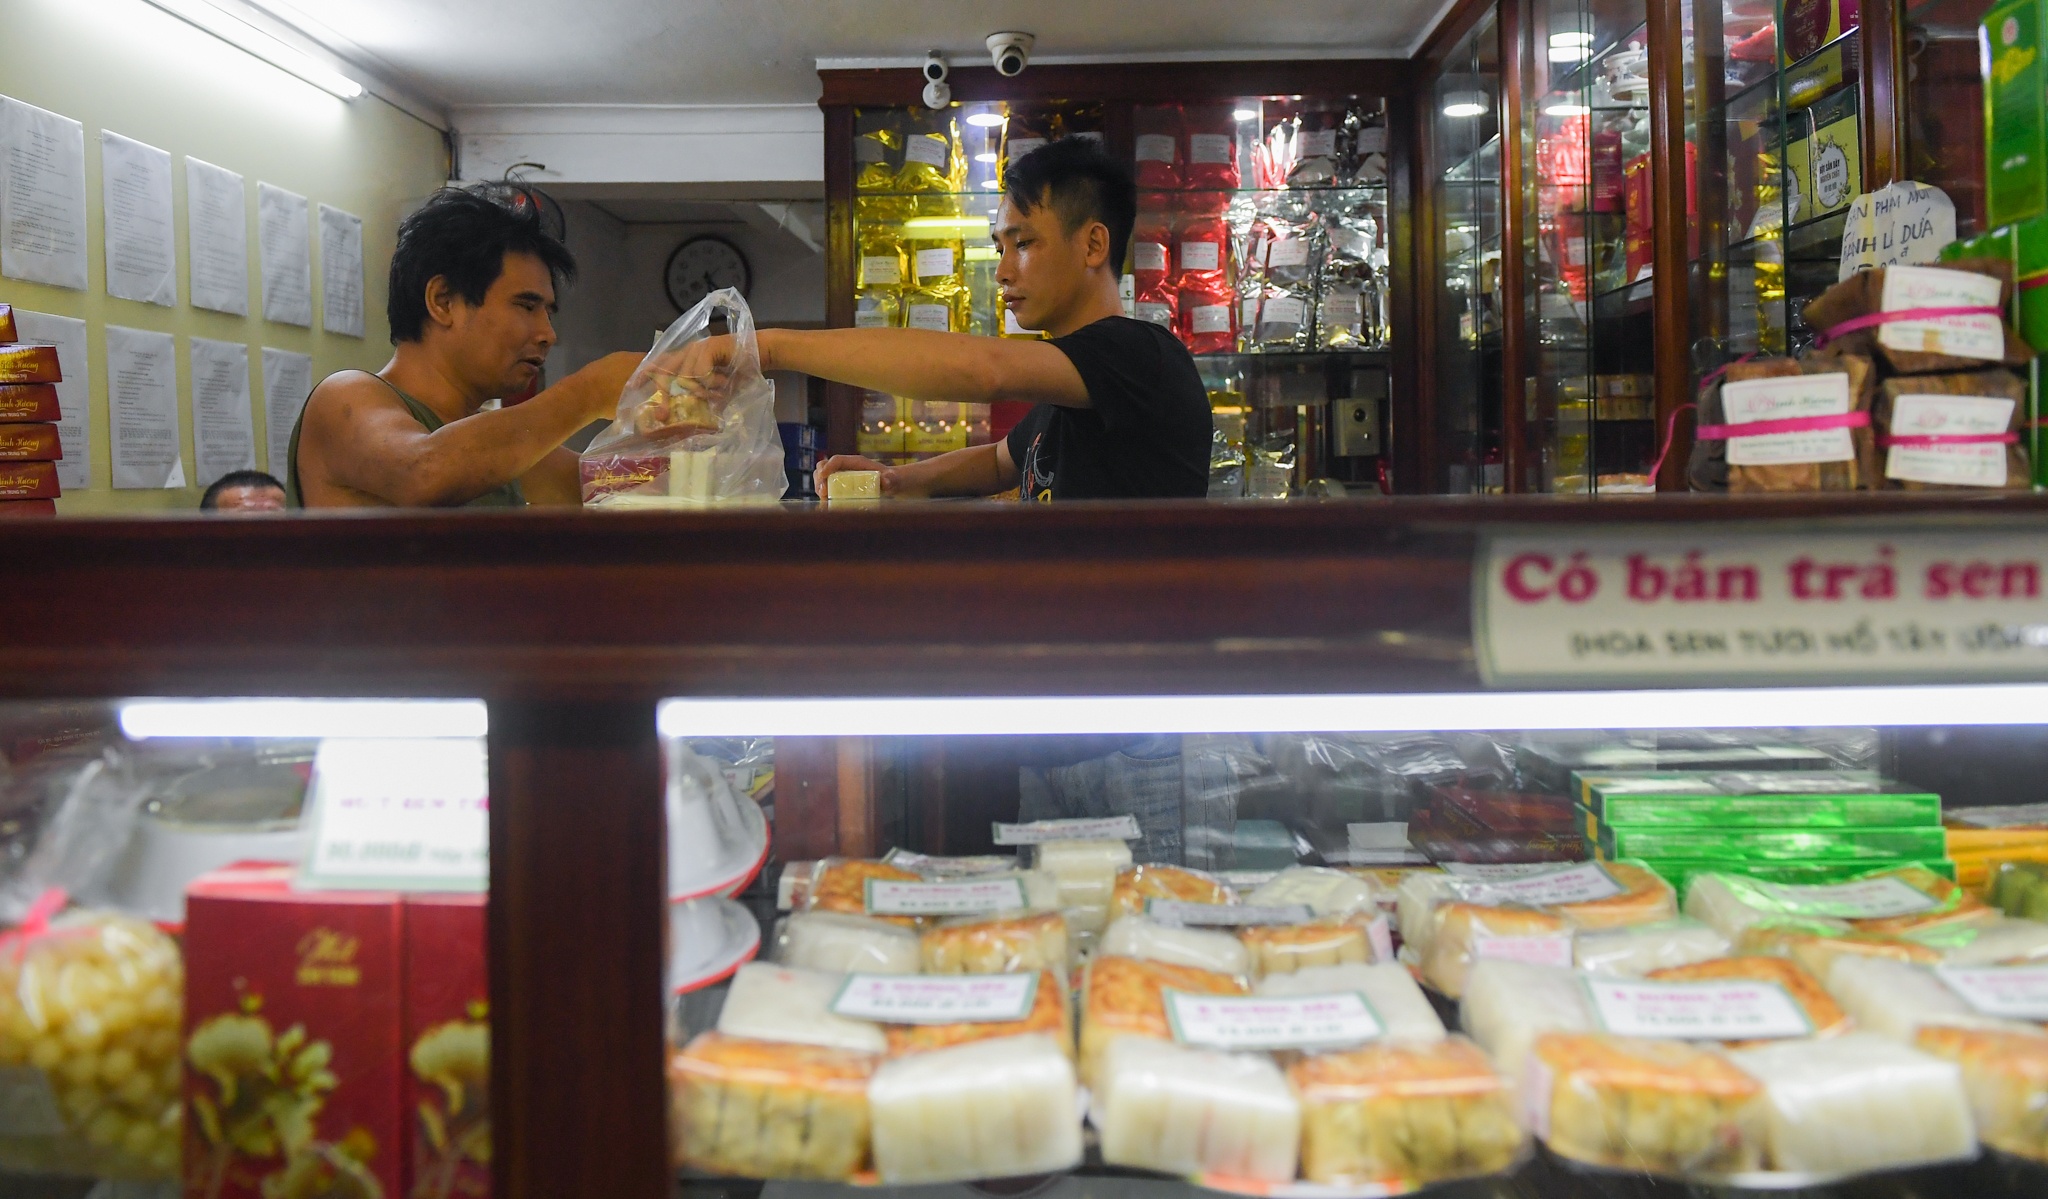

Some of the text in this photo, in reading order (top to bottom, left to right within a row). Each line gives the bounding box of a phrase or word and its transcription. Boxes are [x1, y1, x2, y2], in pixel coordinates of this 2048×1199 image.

[1503, 550, 1600, 604] Có
[1626, 549, 1759, 604] bán
[1924, 563, 2038, 602] sen
